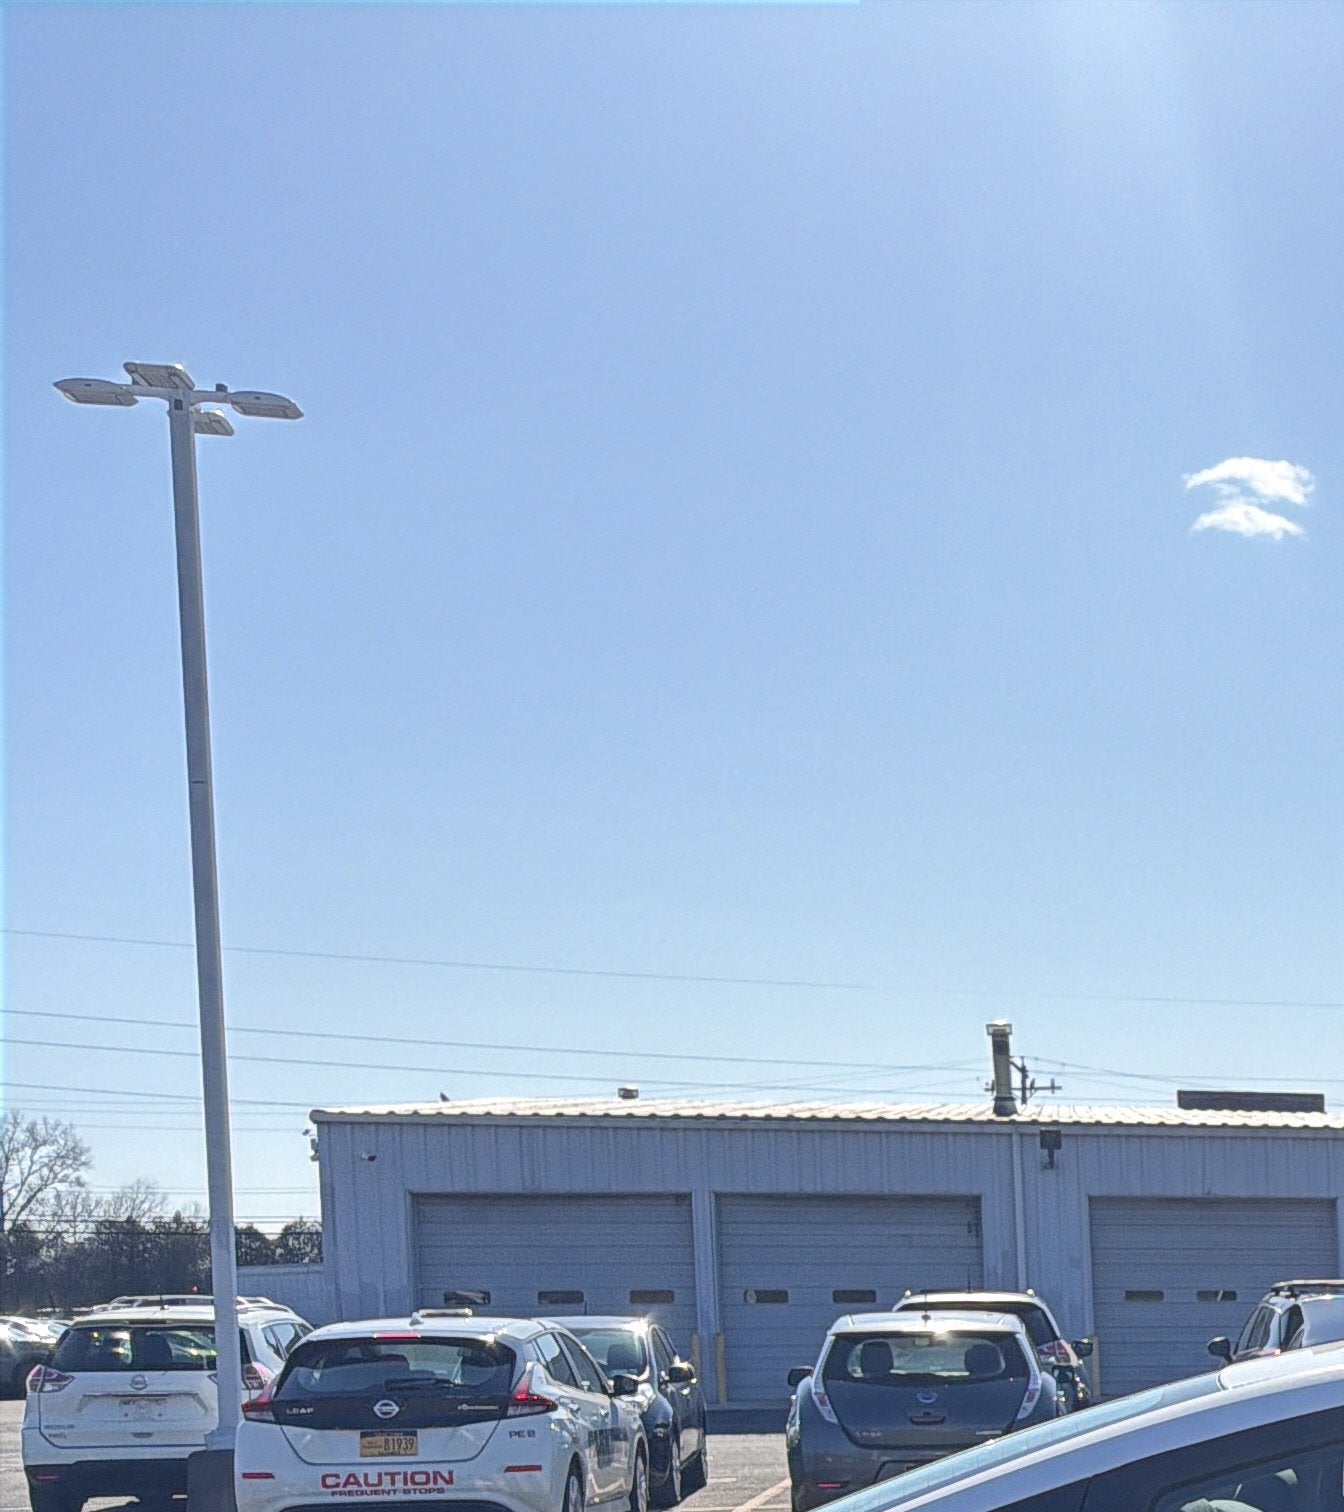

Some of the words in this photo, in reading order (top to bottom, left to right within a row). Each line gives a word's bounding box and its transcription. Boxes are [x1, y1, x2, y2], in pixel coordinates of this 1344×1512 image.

[321, 1470, 455, 1489] CAUTION
[331, 1488, 398, 1497] FREQUENT
[402, 1487, 445, 1495] STOPS
